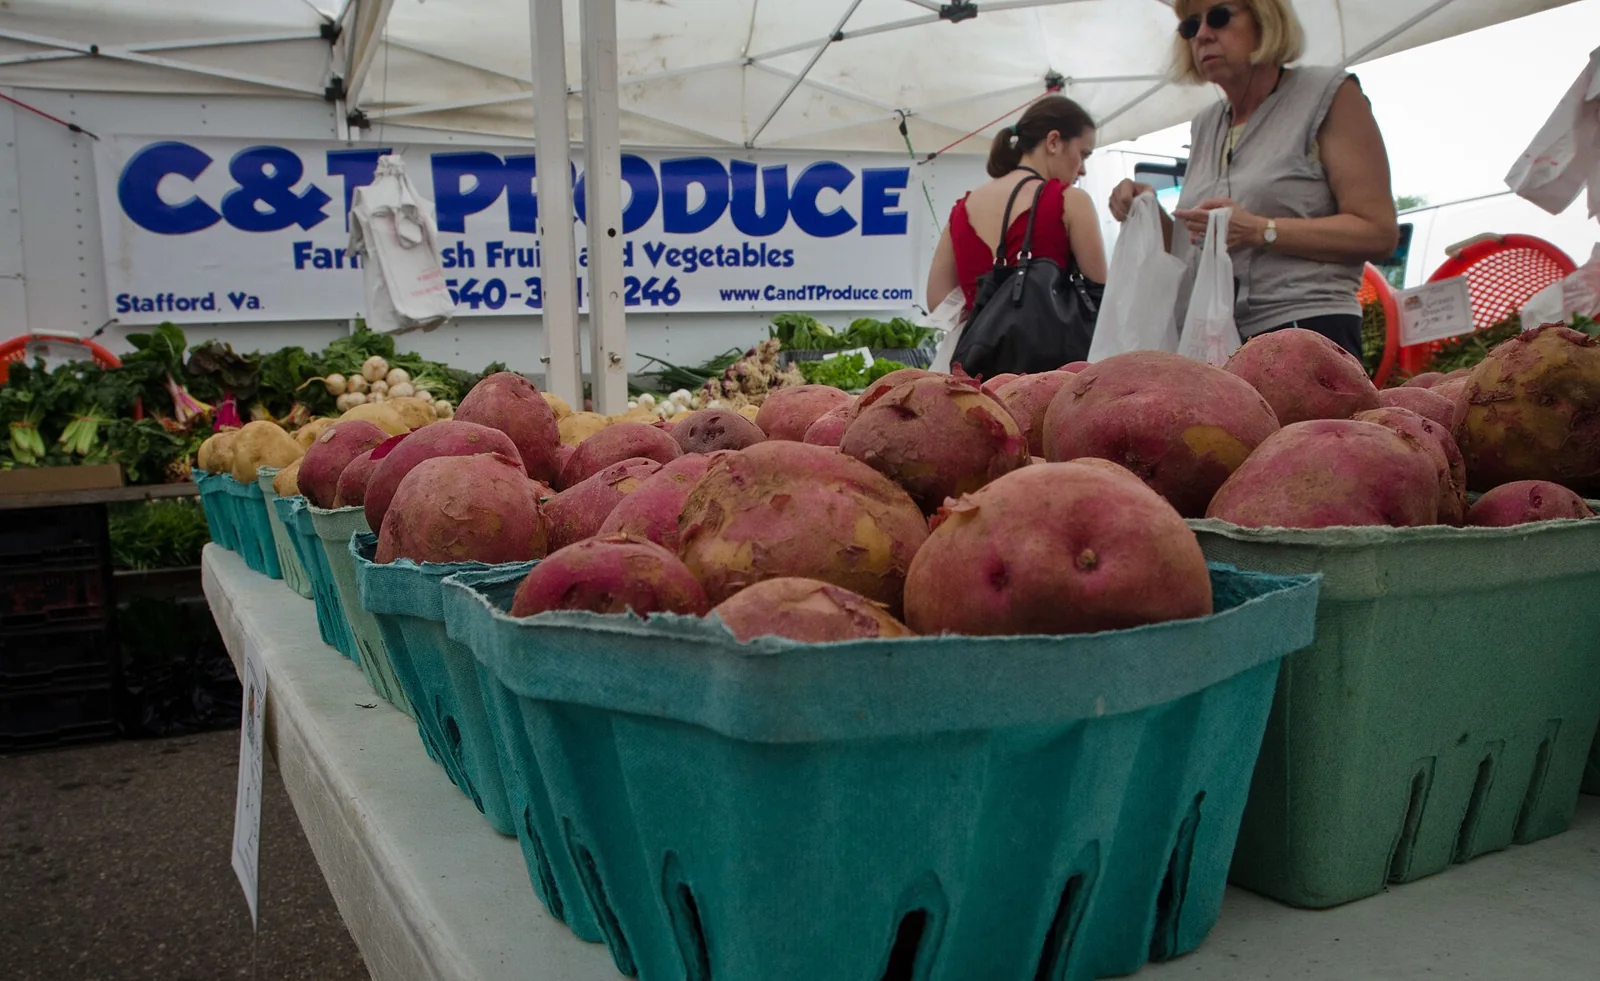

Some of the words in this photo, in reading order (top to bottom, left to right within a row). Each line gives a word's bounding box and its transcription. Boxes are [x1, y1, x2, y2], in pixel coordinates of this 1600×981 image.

[117, 141, 393, 235] C&T
[430, 151, 910, 238] PRODUCE
[642, 241, 794, 272] Vegetables
[116, 292, 221, 313] Stafford,
[227, 291, 265, 310] Va.
[719, 285, 913, 301] www.CandTProduce.com
